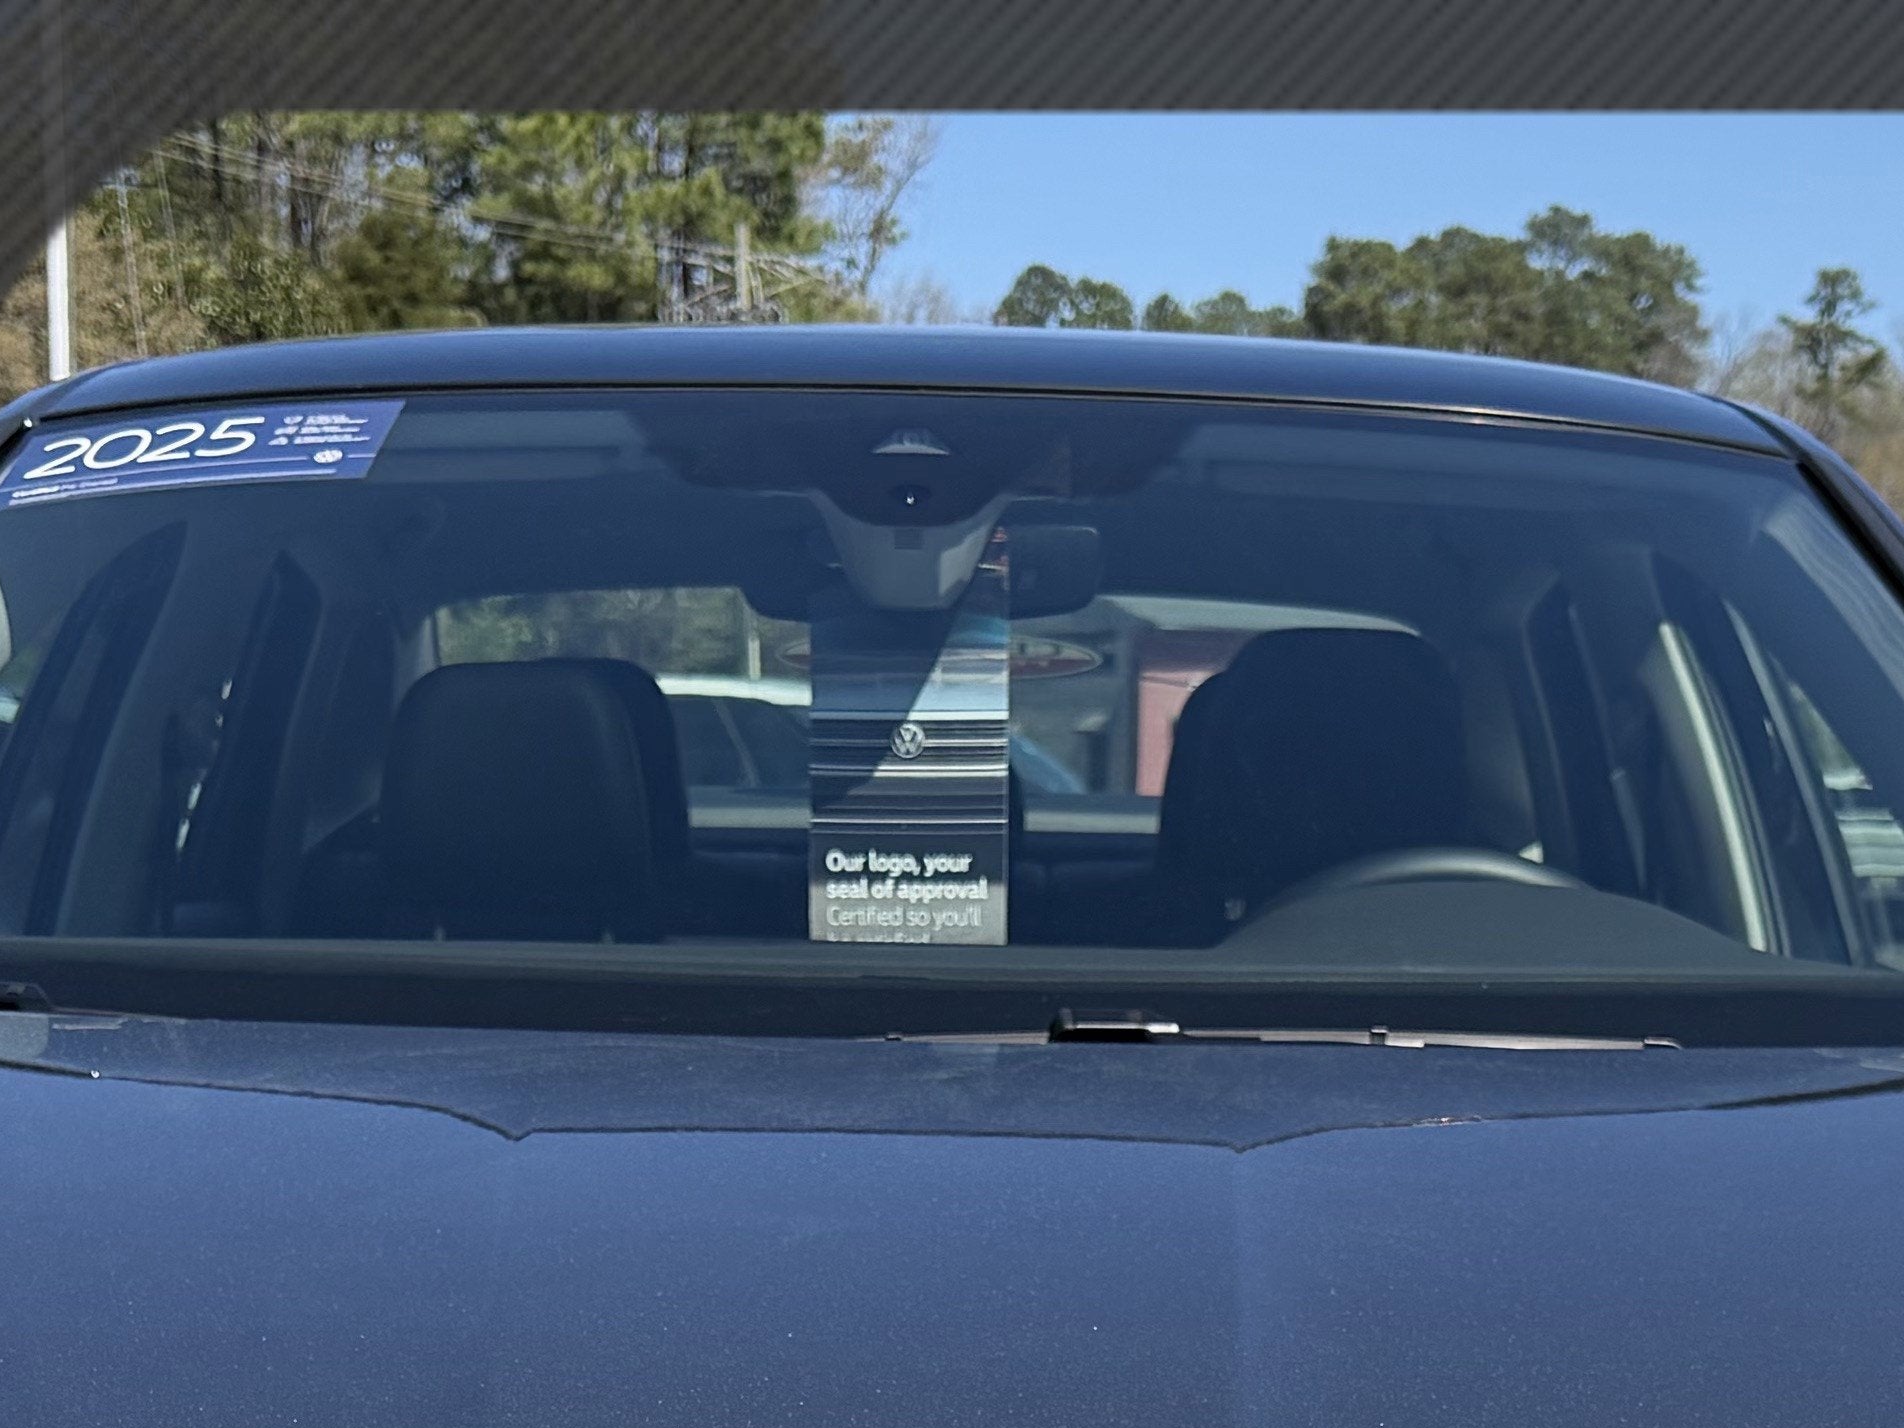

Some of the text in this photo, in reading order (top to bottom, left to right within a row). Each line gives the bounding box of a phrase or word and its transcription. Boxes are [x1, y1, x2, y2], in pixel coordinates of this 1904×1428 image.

[22, 415, 266, 480] 2025
[825, 847, 974, 878] Our logo, your
[825, 874, 989, 904] seal of approval
[826, 903, 904, 927] Certified
[905, 908, 932, 927] so
